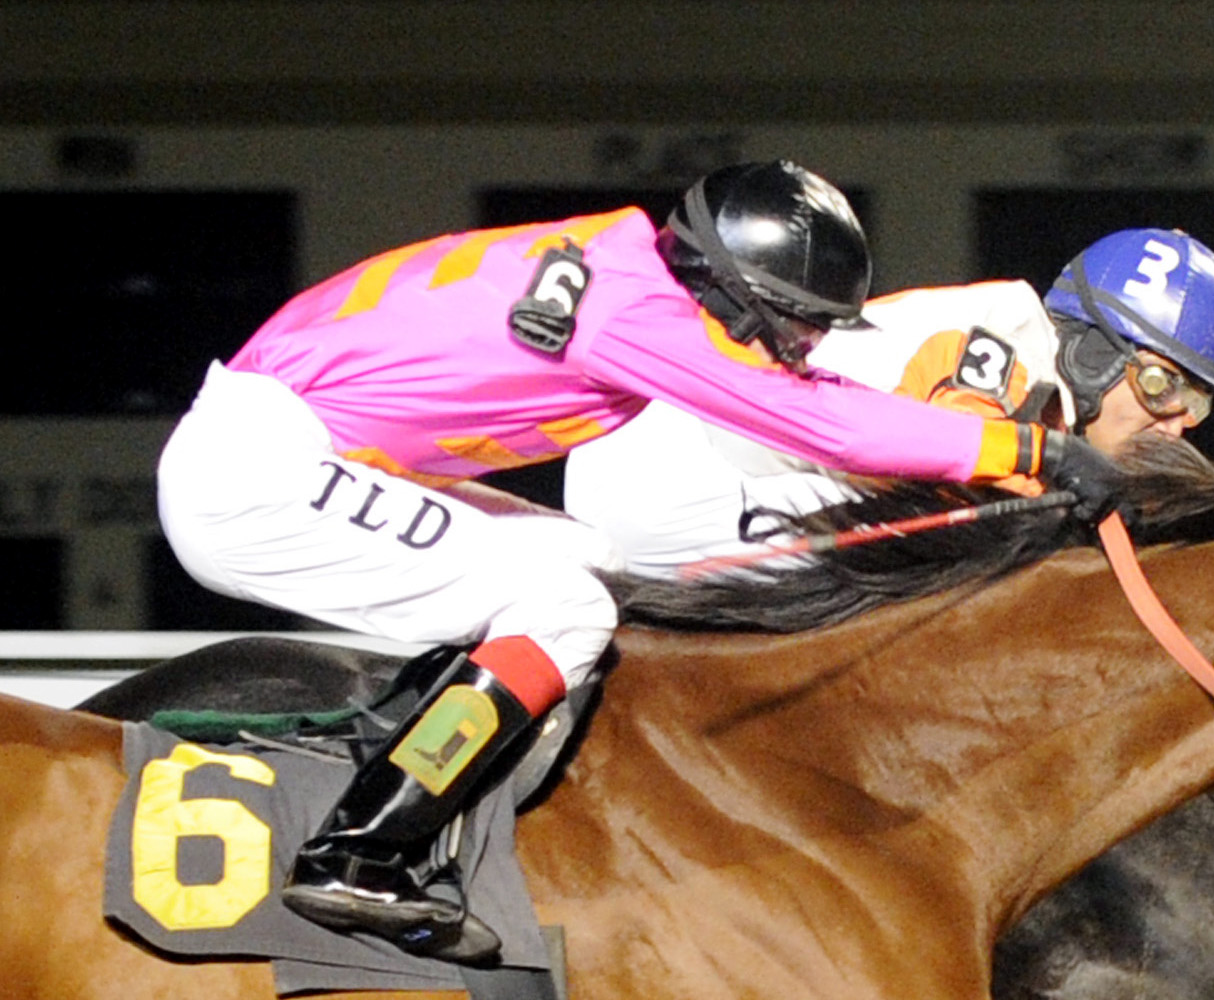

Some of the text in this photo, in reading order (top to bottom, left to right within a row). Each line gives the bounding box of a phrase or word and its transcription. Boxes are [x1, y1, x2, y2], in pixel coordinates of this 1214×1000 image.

[1123, 238, 1180, 299] 3
[961, 337, 1007, 390] 3
[310, 461, 452, 550] TLD
[132, 742, 275, 931] 6
